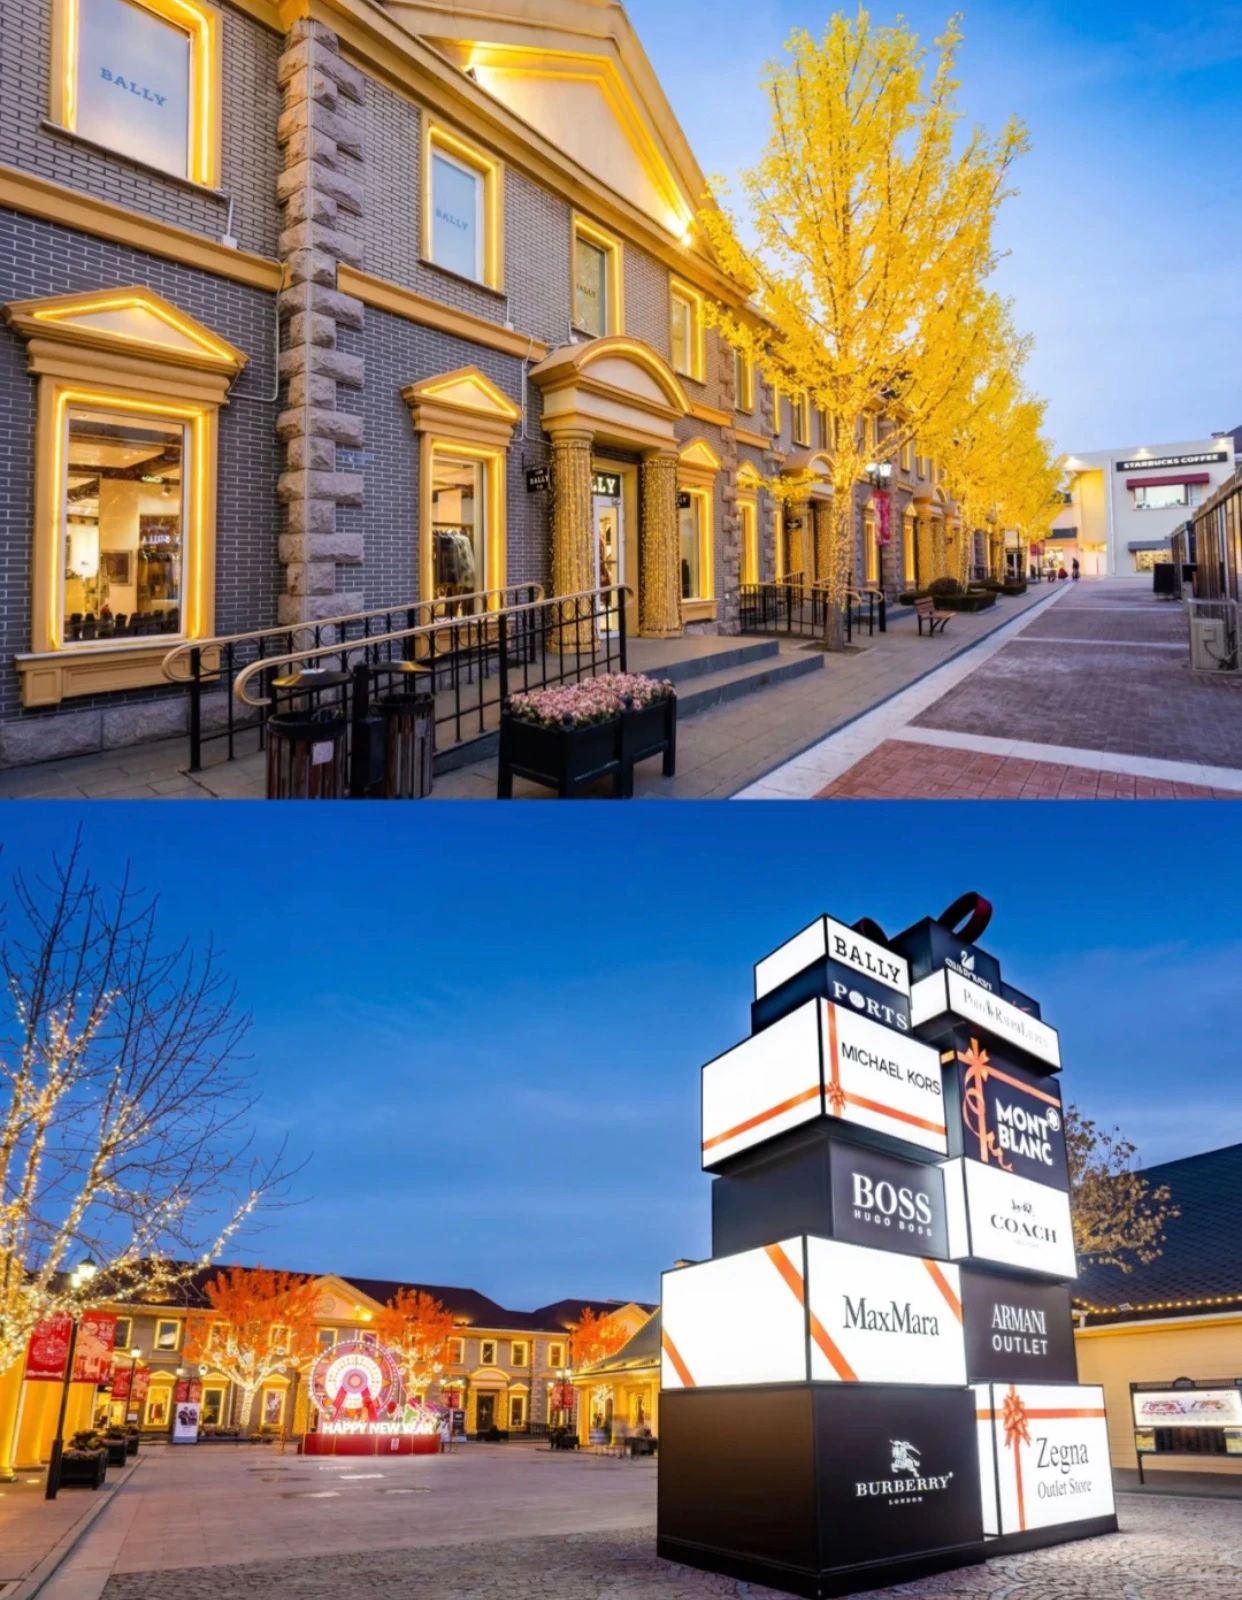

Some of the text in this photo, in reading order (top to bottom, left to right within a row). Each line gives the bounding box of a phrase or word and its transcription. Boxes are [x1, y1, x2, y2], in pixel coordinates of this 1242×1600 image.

[100, 66, 168, 106] BALLY
[435, 207, 469, 231] BALLY
[1123, 454, 1220, 469] STARBUCKS COFFEE
[833, 934, 901, 984] BALLY
[832, 980, 908, 1031] PORTS
[841, 1041, 941, 1096] MICHAEL KORS
[995, 1097, 1048, 1141] MONT
[997, 1123, 1053, 1166] BLANC
[851, 1172, 932, 1225] BOSS
[853, 1209, 933, 1238] HUGO BOSS
[990, 1213, 1057, 1244] COACH
[842, 1294, 940, 1336] MaxMara
[991, 1303, 1047, 1335] ARMANI
[992, 1334, 1048, 1356] OUTLET
[321, 1421, 367, 1435] HAPPY
[369, 1421, 399, 1435] NEW
[1036, 1437, 1089, 1475] Zegna
[855, 1475, 949, 1497] BURBERRY
[1037, 1477, 1092, 1499] Outlet Store
